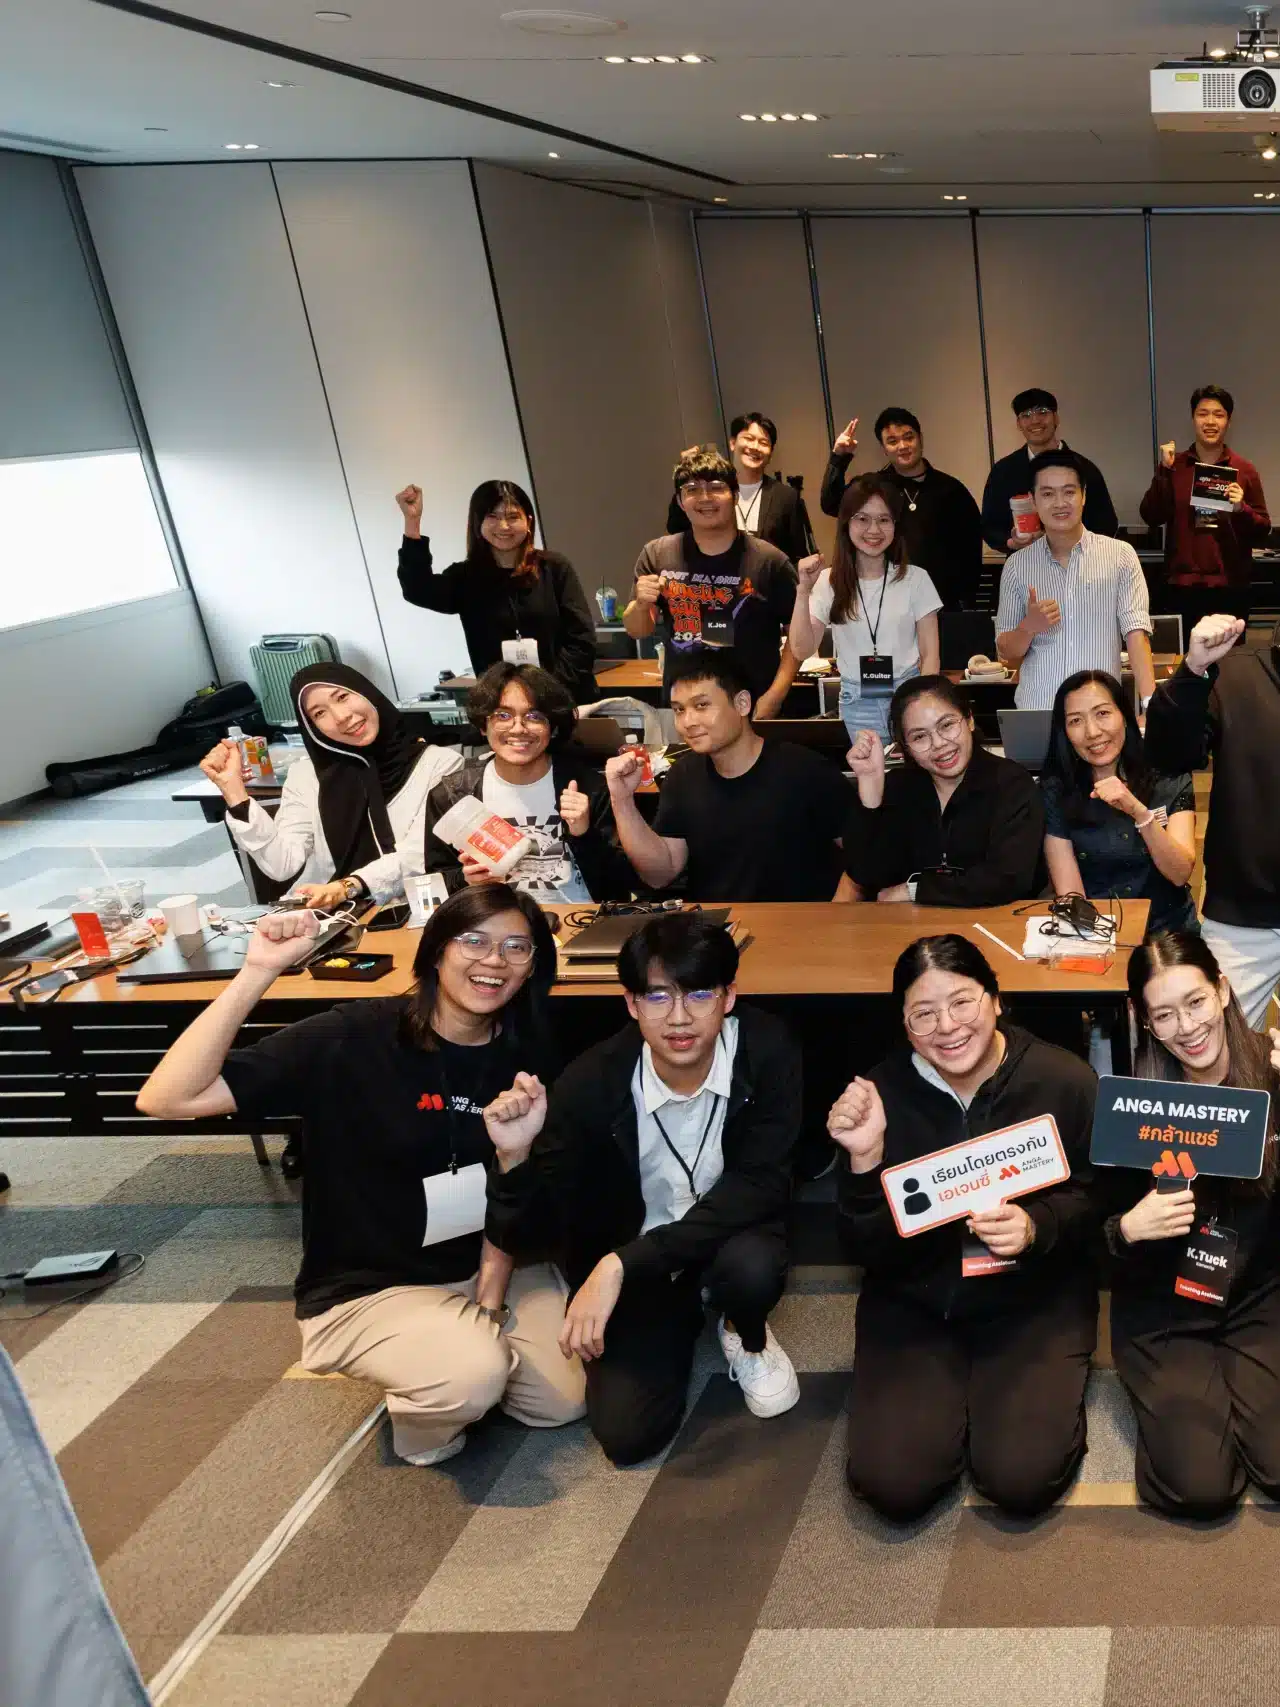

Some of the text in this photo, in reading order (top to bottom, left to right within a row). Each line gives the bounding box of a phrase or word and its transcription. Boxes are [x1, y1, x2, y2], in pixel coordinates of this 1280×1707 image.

[691, 573, 741, 585] MAONE
[673, 631, 702, 641] 202
[1112, 1097, 1250, 1124] ANGA MASTERY
[1138, 1124, 1220, 1147] #กล้าแชร์
[931, 1135, 1048, 1184] เรียนโดยตรงกับ
[1021, 1156, 1042, 1167] ANGA
[1022, 1157, 1055, 1172] MASTERY
[938, 1169, 991, 1202] เอเจนซี่
[1186, 1246, 1228, 1269] K.Tuck
